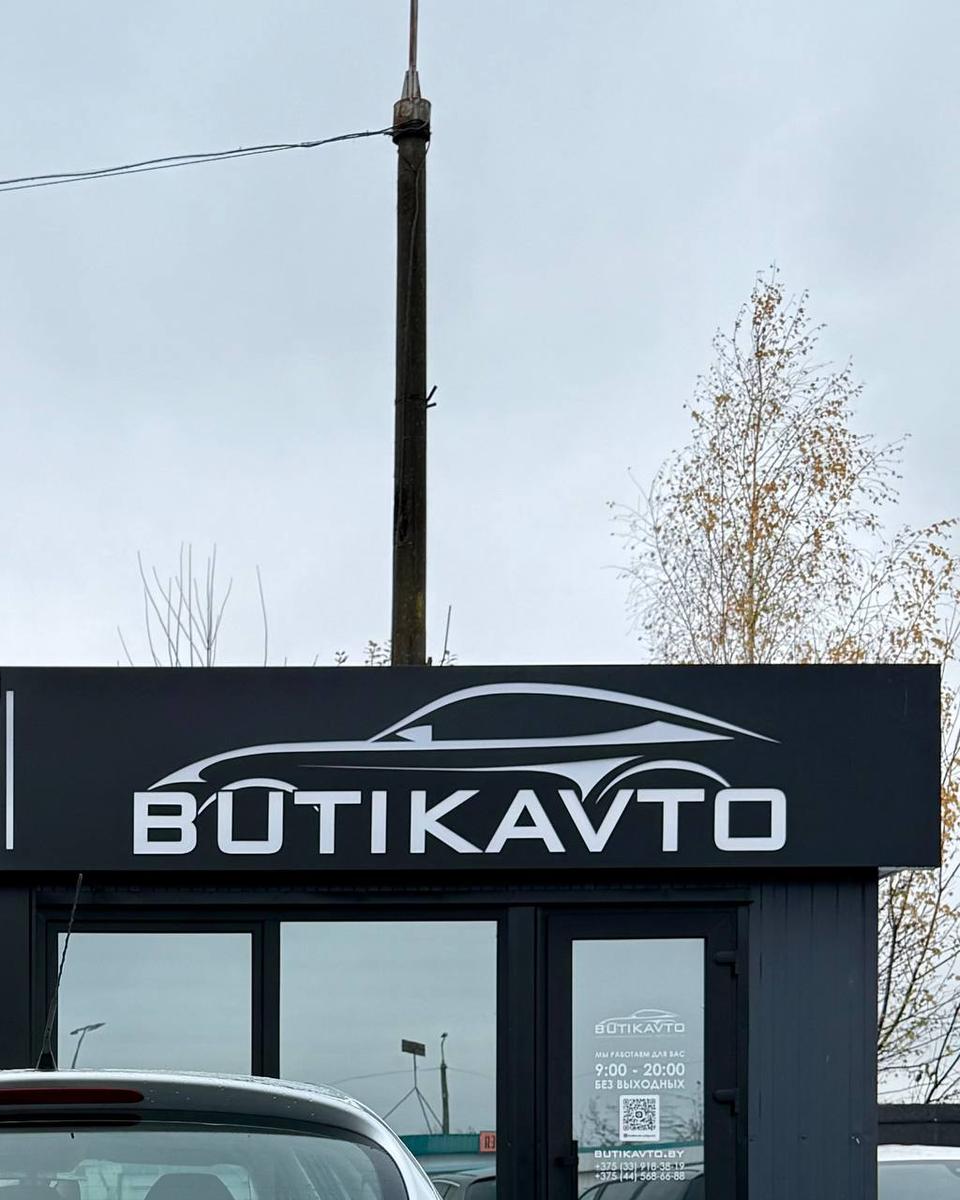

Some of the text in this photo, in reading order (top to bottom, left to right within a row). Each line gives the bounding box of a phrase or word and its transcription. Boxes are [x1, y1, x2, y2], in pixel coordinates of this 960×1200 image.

[133, 786, 787, 855] BUTIKAVTO
[595, 1022, 685, 1034] BUTIKAVTO
[595, 1063, 627, 1077] 9:00
[643, 1062, 685, 1076] 20:00
[594, 1080, 685, 1090] БЕЗ ВЫХОДНЫХ
[594, 1150, 685, 1158] BUTIKAVTO.BY
[595, 1162, 685, 1173] +375 (33) 918-38-19
[595, 1172, 685, 1182] +375 (44) 568-66-88
